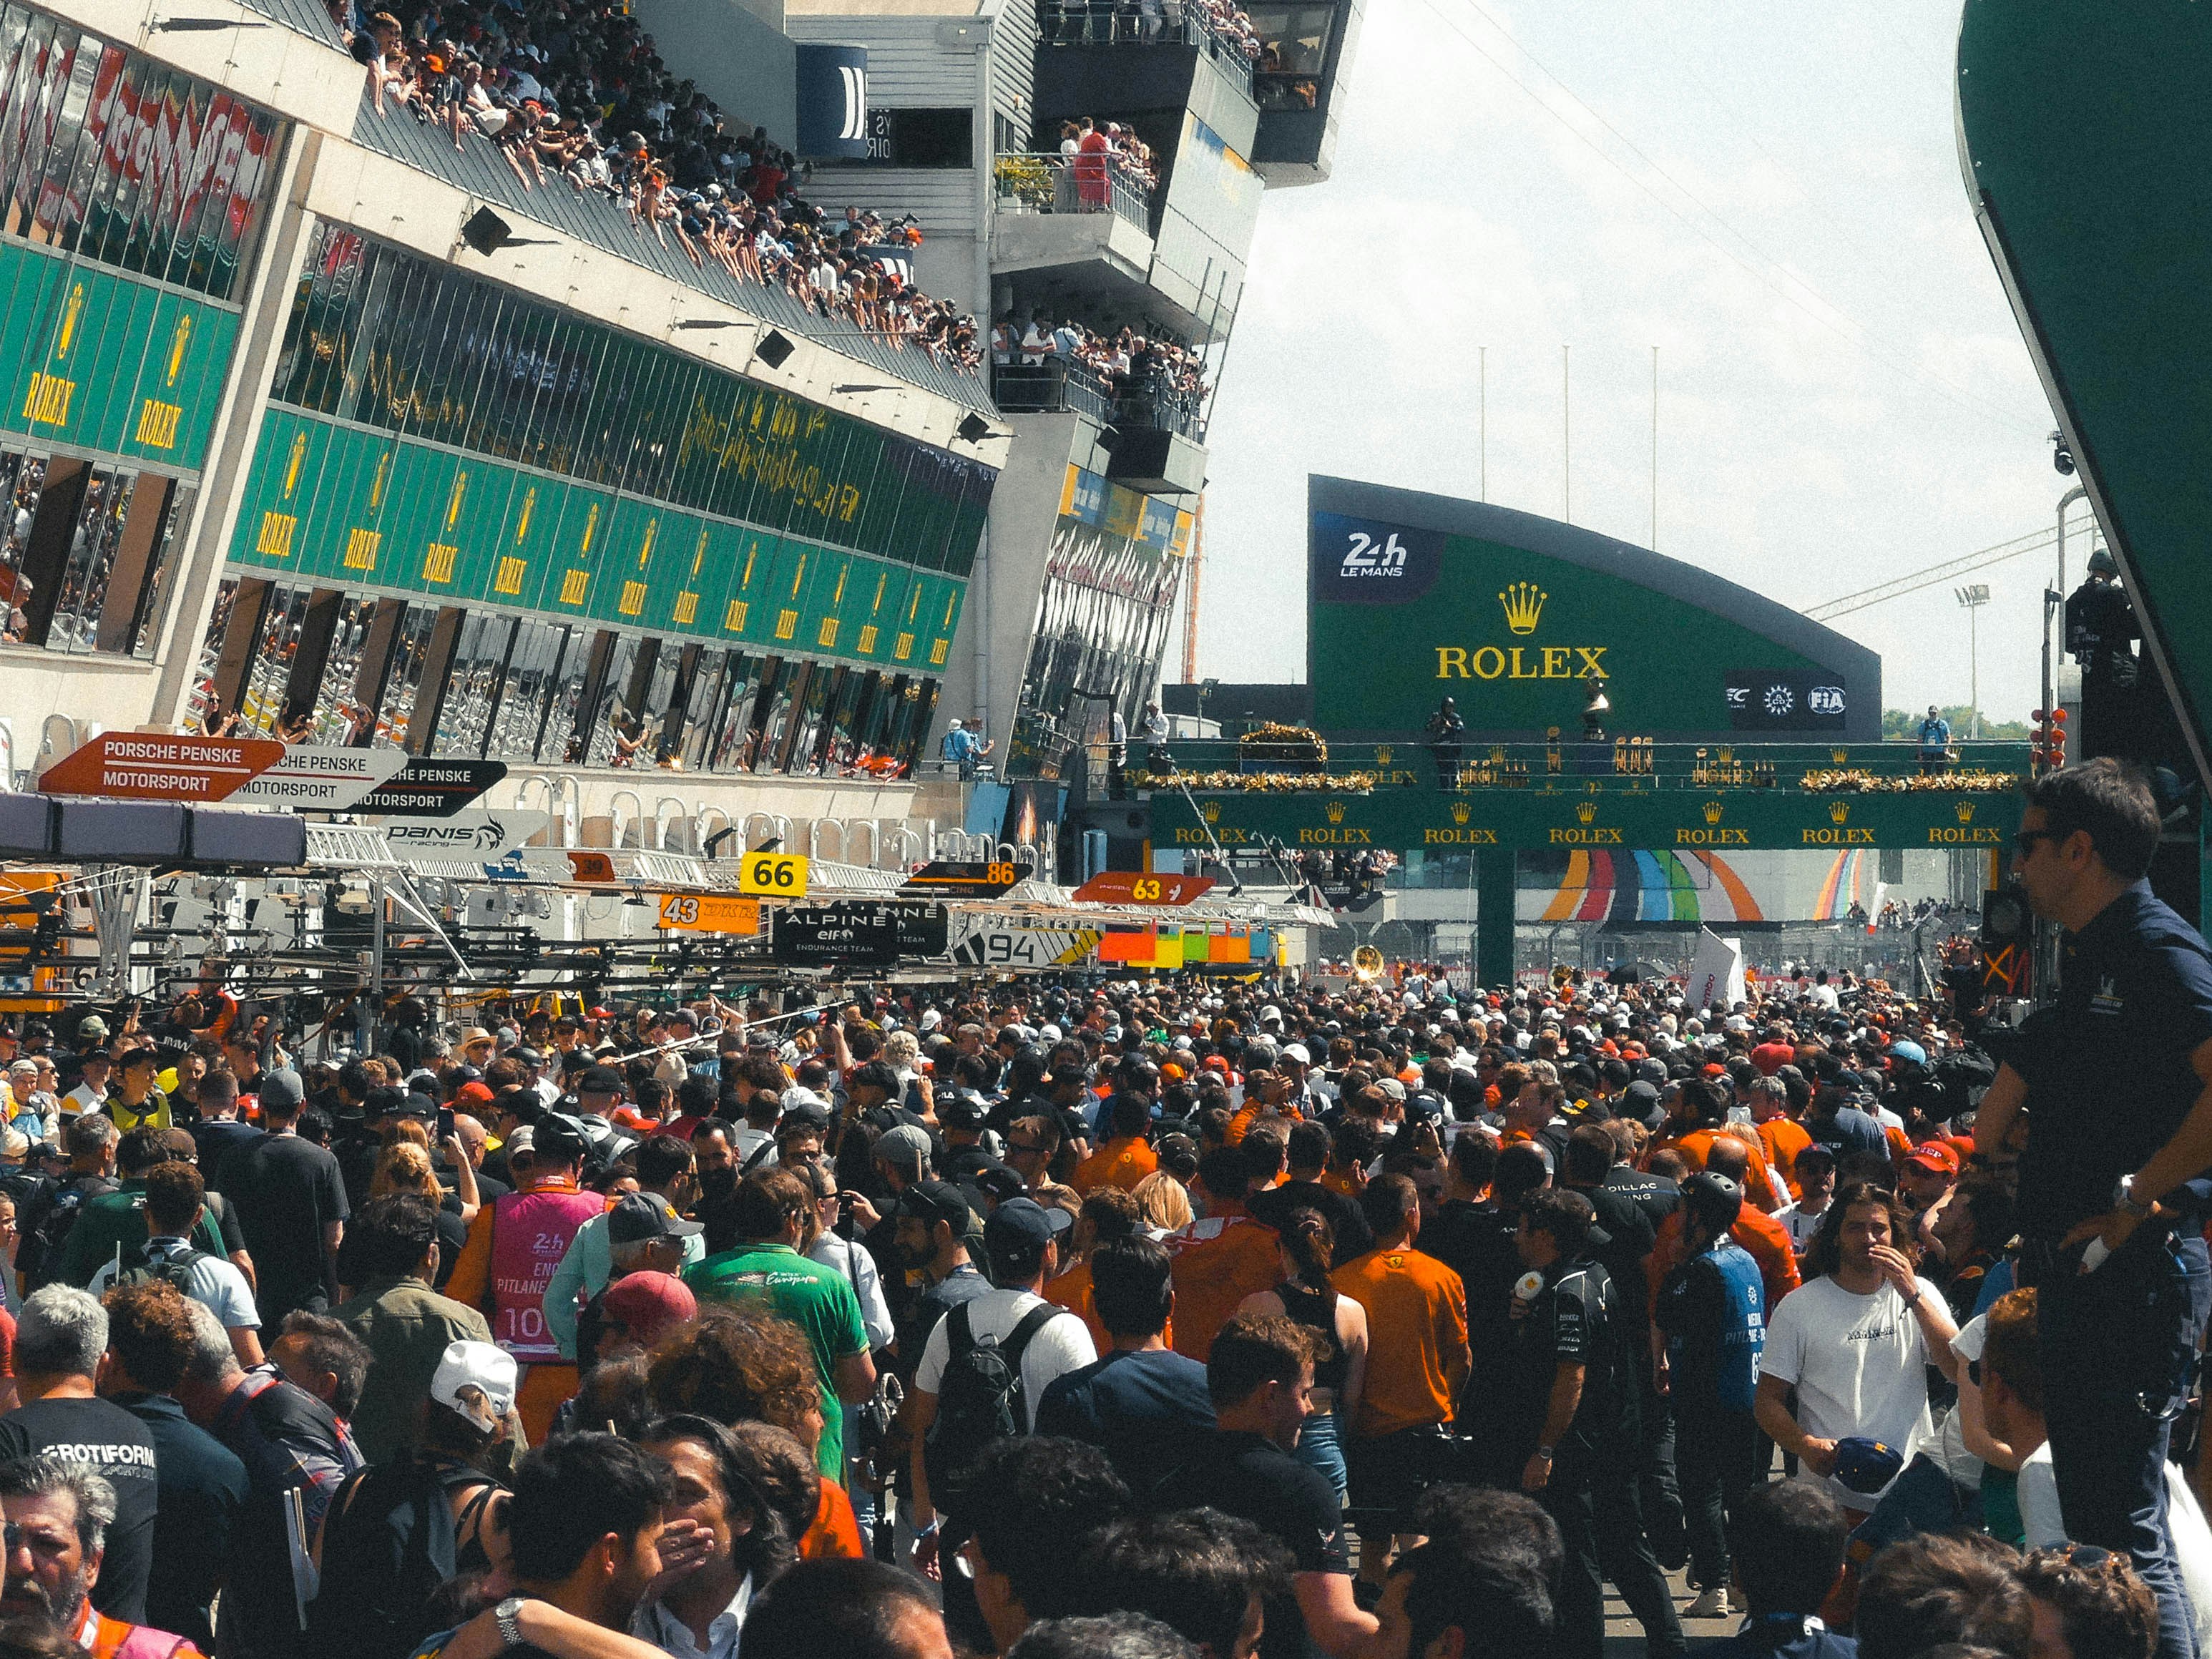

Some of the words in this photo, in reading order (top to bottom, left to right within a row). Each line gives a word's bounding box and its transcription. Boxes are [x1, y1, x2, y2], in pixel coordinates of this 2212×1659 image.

[22, 372, 75, 426] ROLEX
[135, 399, 182, 449] ROLEX
[256, 512, 298, 557] ROLEX
[343, 528, 381, 570] ROLEX
[422, 543, 458, 583] ROLEX
[1340, 567, 1358, 577] LE
[1360, 567, 1403, 577] MANS
[1435, 646, 1610, 679] ROLEX
[104, 741, 177, 760] PORSCHE
[180, 745, 241, 763] PENSKE
[310, 756, 366, 772] PENSKE
[103, 771, 210, 791] MOTORSPORT
[421, 770, 471, 783] PENSKE
[238, 781, 337, 798] MOTORSPORT
[1299, 828, 1371, 843] ROLEX
[1424, 828, 1497, 843] ROLEX
[1550, 828, 1623, 843] ROLEX
[1676, 828, 1749, 843] ROLEX
[1803, 828, 1875, 843] ROLEX
[1929, 828, 2002, 842] ROLEX
[753, 860, 794, 887] 66
[987, 862, 1014, 885] 86
[1133, 879, 1160, 900] 63
[662, 897, 700, 924] 43
[786, 914, 886, 927] ALPINE
[817, 930, 840, 940] elf
[796, 944, 848, 952] ENDURANCE
[851, 944, 874, 953] TEAM
[989, 934, 1034, 964] 94
[497, 1278, 547, 1294] PITLANE
[57, 1444, 155, 1468] ROTIFORM
